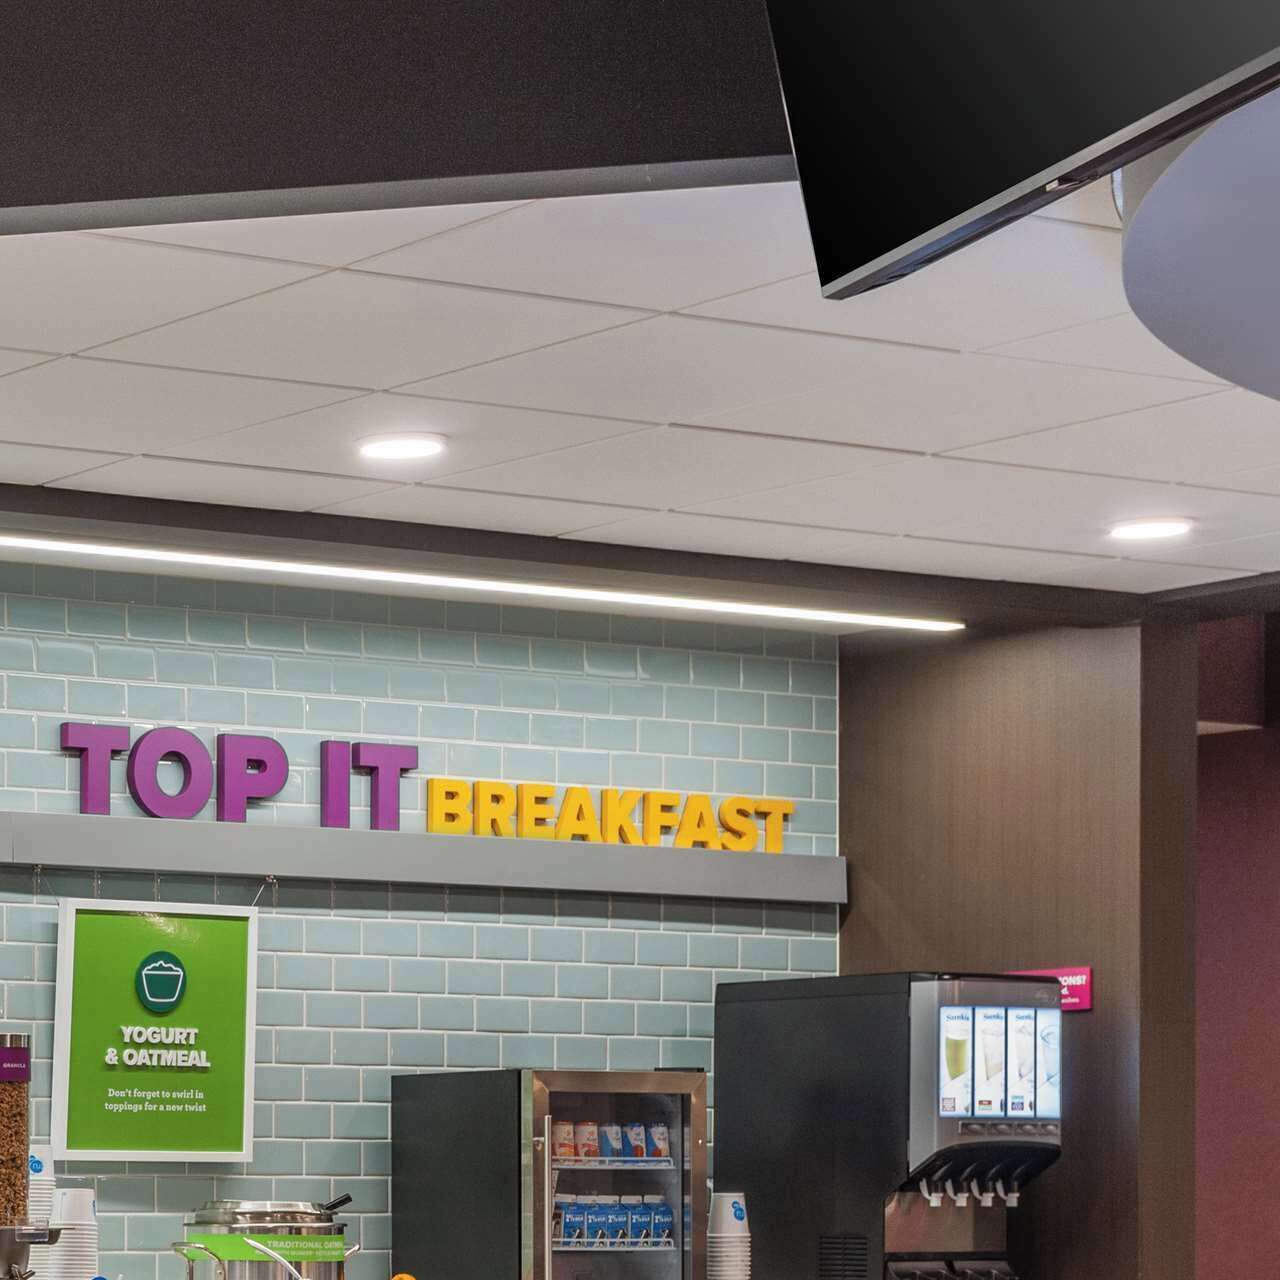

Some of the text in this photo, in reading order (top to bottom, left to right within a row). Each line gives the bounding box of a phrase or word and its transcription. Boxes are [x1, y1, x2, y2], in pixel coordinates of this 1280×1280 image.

[60, 721, 798, 854] TOP IT BREAKFAST
[121, 1026, 199, 1045] YOGURT
[105, 1048, 211, 1068] & OATMEAL
[107, 1088, 204, 1101] Don't forget to swirl in
[104, 1102, 207, 1113] toppings for a new twist
